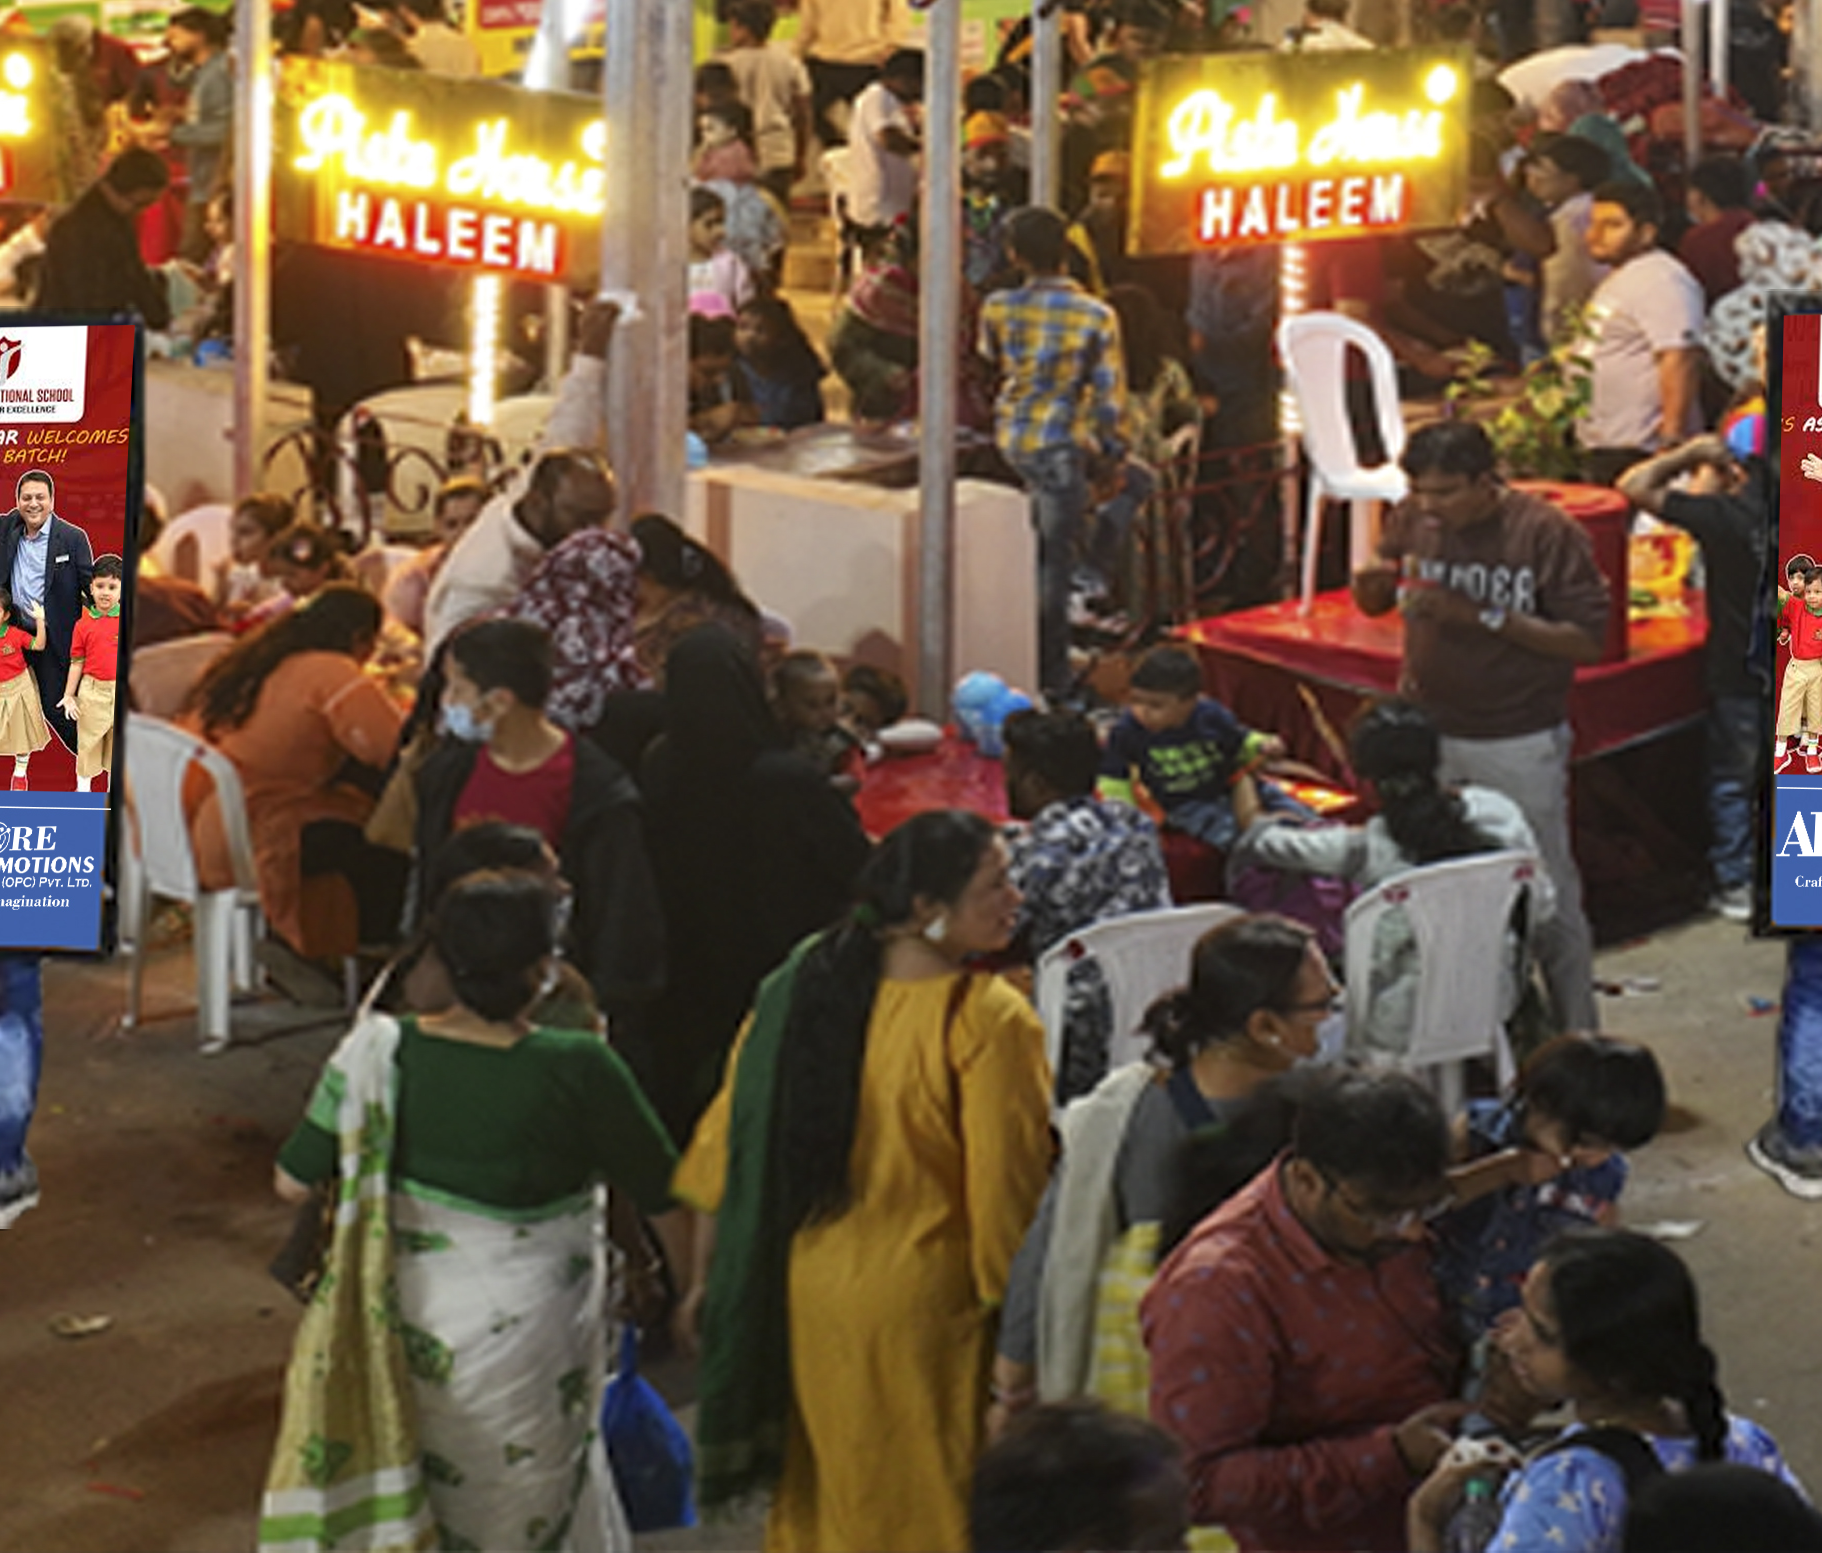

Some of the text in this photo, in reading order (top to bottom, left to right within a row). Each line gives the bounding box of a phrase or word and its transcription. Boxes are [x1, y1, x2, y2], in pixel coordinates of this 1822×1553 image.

[1199, 172, 1403, 240] HALEEM
[335, 192, 557, 272] HALEEM
[36, 389, 74, 403] SCHOOL
[7, 405, 56, 415] EXCELLENCE
[27, 428, 129, 445] WELCOMES
[3, 449, 68, 464] BATCH!
[1, 876, 36, 889] (OPC)
